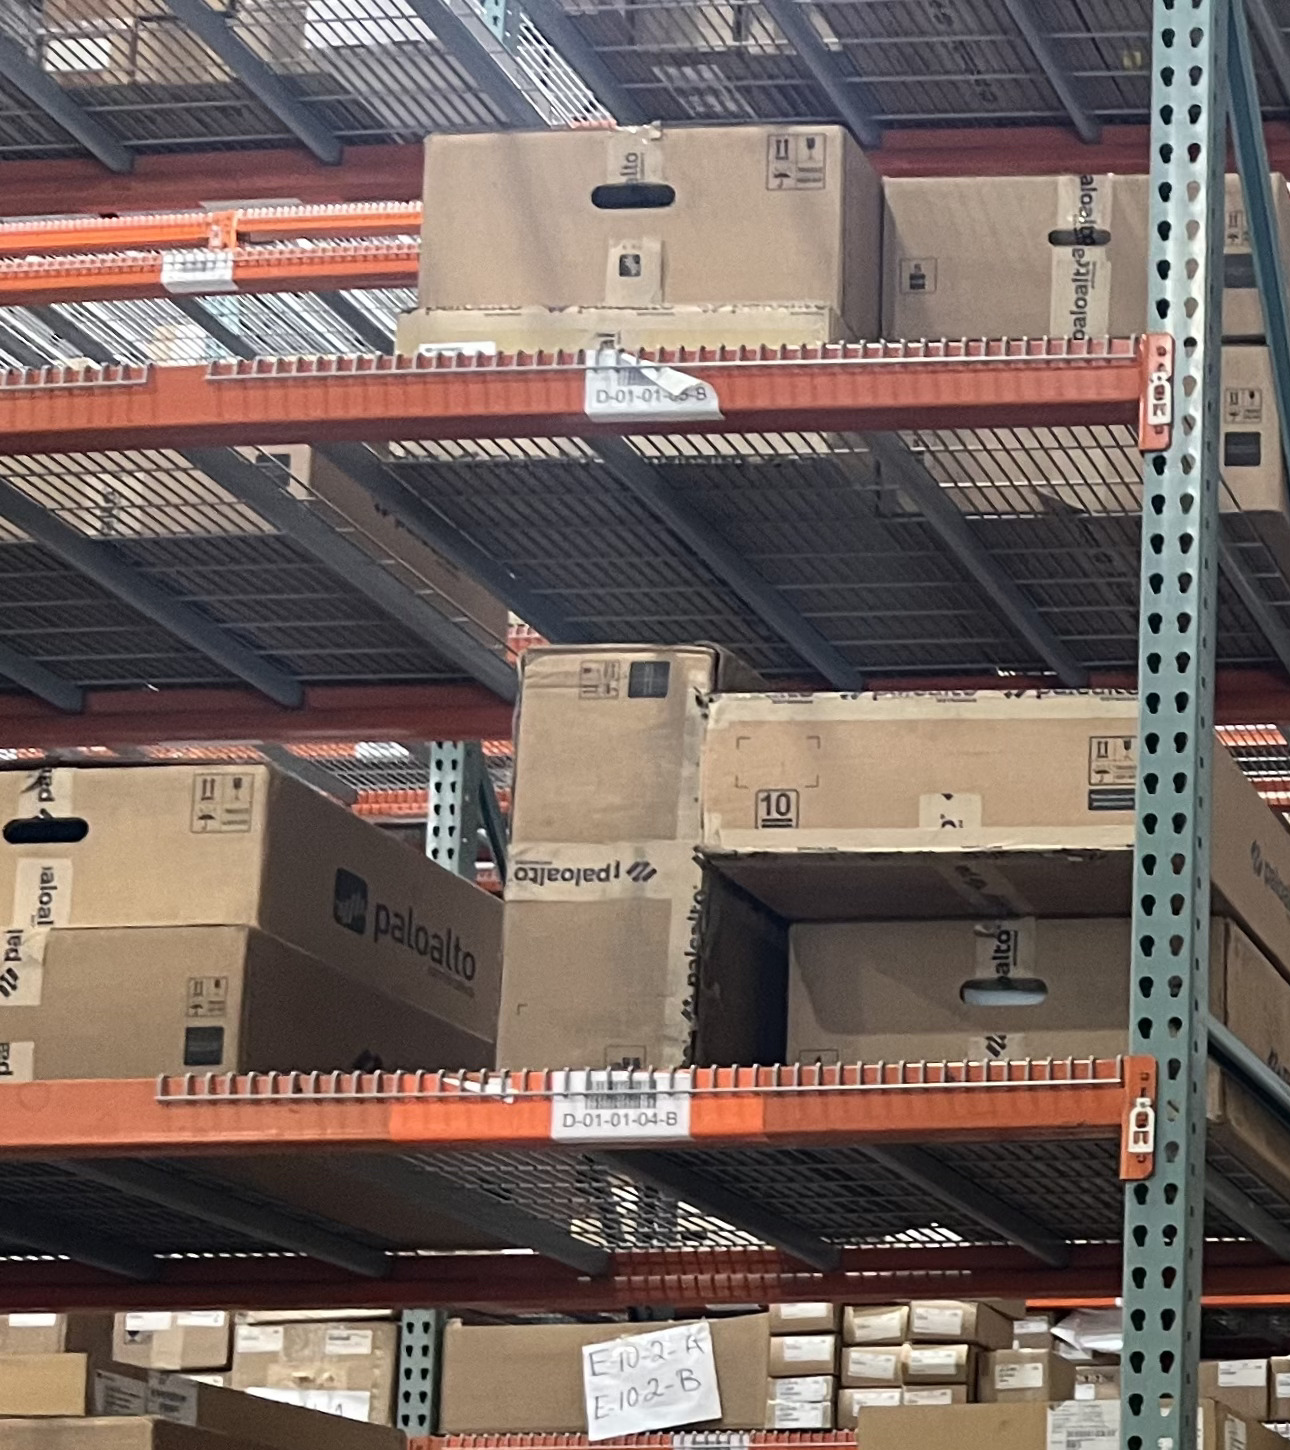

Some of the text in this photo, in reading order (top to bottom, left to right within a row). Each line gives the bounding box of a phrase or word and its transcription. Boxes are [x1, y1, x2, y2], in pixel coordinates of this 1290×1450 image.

[760, 791, 791, 816] 10
[514, 862, 611, 887] paloalto
[374, 903, 476, 981] paloalto
[562, 1111, 678, 1128] D-01-01-04-B
